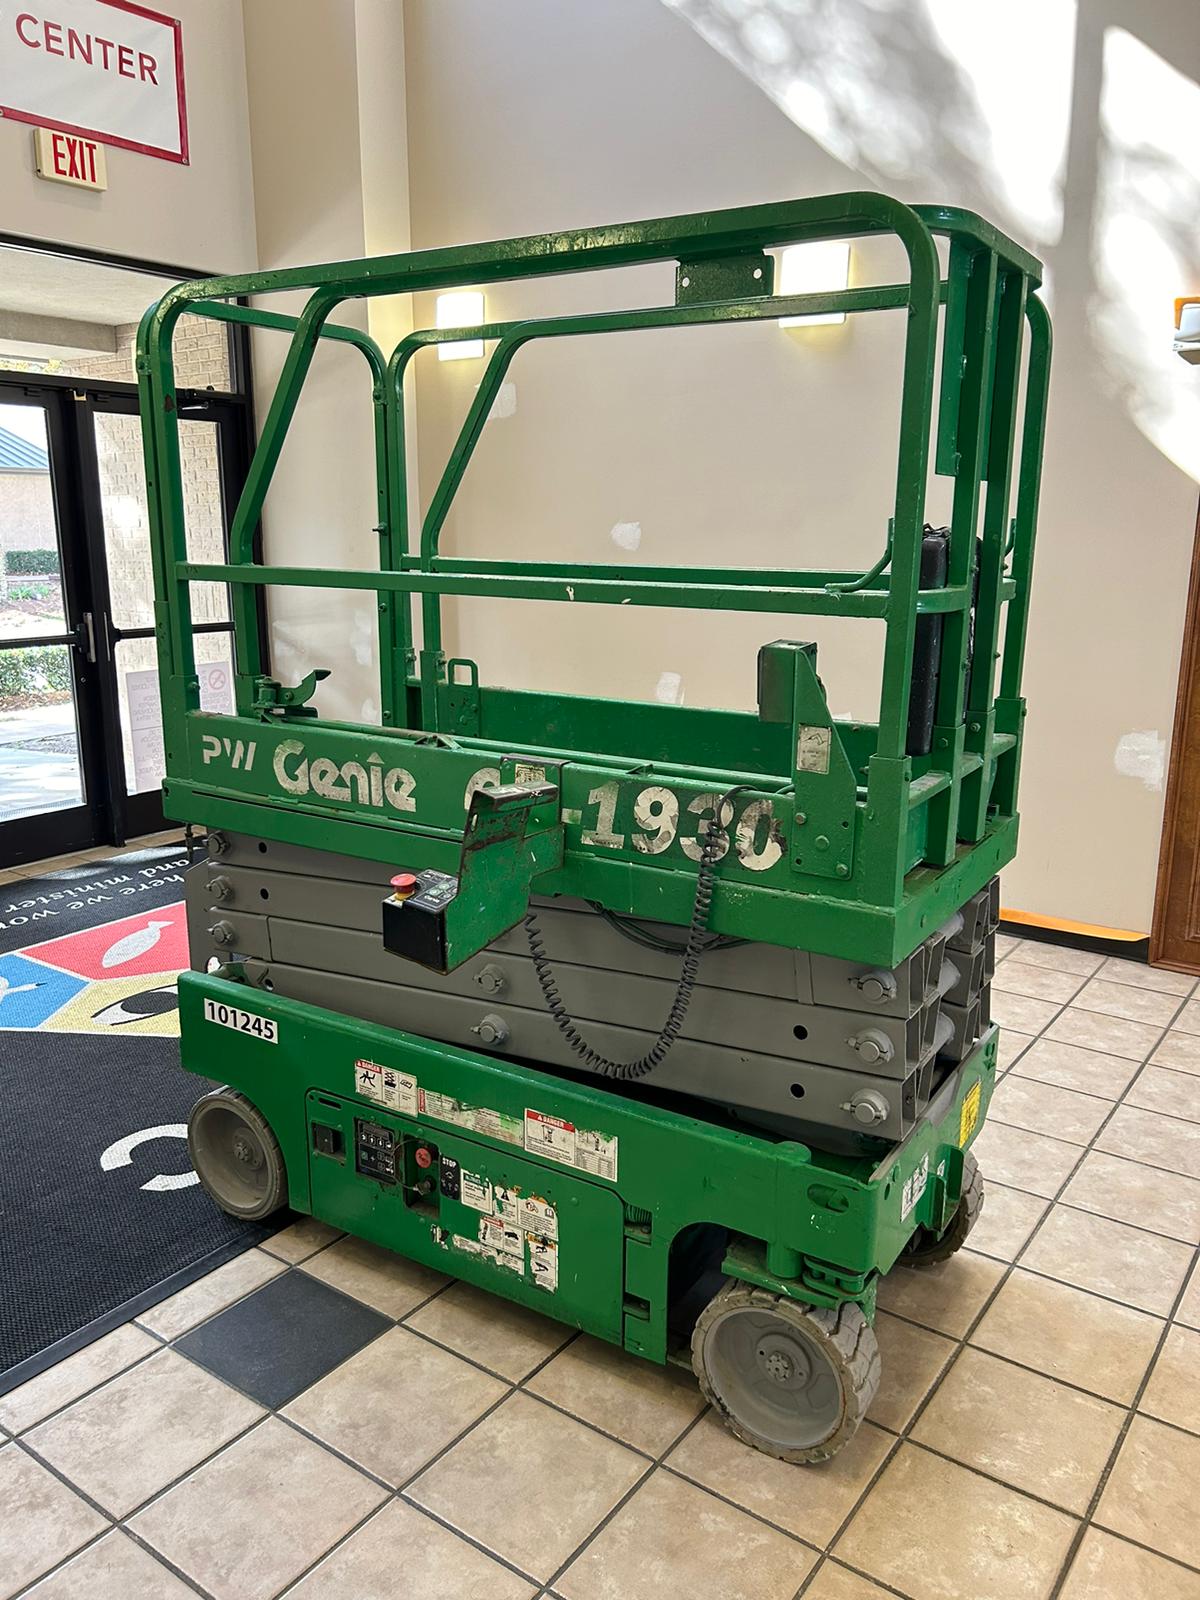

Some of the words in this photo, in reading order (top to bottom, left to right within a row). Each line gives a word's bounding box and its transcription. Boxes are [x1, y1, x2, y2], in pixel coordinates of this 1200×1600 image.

[15, 13, 159, 86] CENTER
[52, 134, 97, 183] EXIT
[273, 738, 416, 812] Genie
[138, 858, 190, 877] and
[4, 874, 133, 913] minister
[119, 873, 185, 895] here
[66, 893, 113, 910] we
[207, 1002, 274, 1040] 101245
[543, 1116, 565, 1129] DANGER
[442, 1157, 457, 1169] STOP
